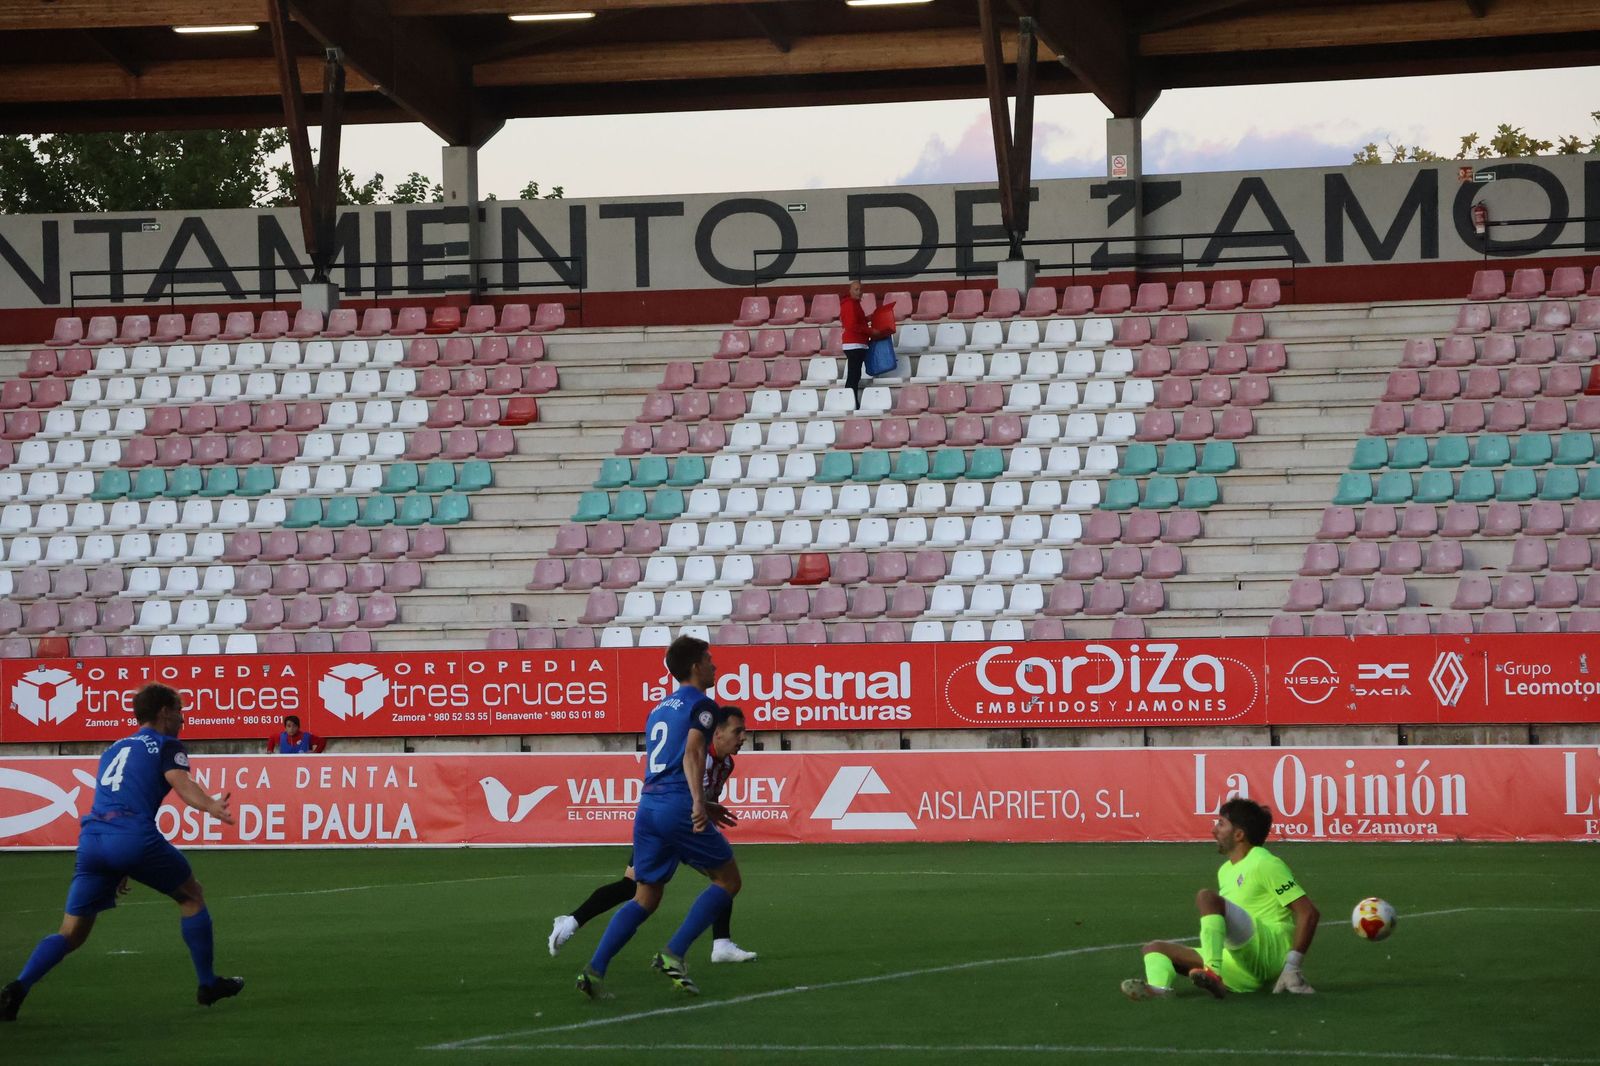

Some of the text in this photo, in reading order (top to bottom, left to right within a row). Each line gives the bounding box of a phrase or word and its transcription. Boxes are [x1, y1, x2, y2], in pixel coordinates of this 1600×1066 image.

[847, 186, 1040, 281] DE
[394, 658, 604, 676] ORTOPEDIA
[1283, 675, 1340, 685] NISSAN
[1503, 660, 1552, 679] Grupo
[391, 680, 608, 708] tres cruces
[642, 661, 912, 702] la dustrial
[1355, 687, 1412, 697] DACIA
[85, 686, 299, 713] tre cruces
[976, 698, 1228, 715] EMBUTIDOS Y JAMONES
[85, 718, 119, 728] Zamora
[188, 714, 236, 726] Benavente
[243, 714, 259, 725] 980
[261, 714, 273, 725] 63
[391, 710, 605, 723] Zamora 980 52 53 55 Benavente 980 63 01 89
[753, 701, 912, 726] de pinturas
[649, 720, 669, 774] 2
[100, 745, 132, 793] 4
[193, 765, 419, 791] NICA DENTAL
[1193, 752, 1469, 838] La Opinión
[1563, 750, 1600, 816] L
[154, 792, 418, 843] OSÉ DE PAULA
[567, 810, 582, 821] EL
[584, 810, 636, 821] CENTRO
[736, 810, 789, 821] ZAMORA
[917, 788, 1140, 824] AISLAPRIETO, S.L.
[1328, 818, 1353, 836] de
[1357, 818, 1439, 836] Zamora
